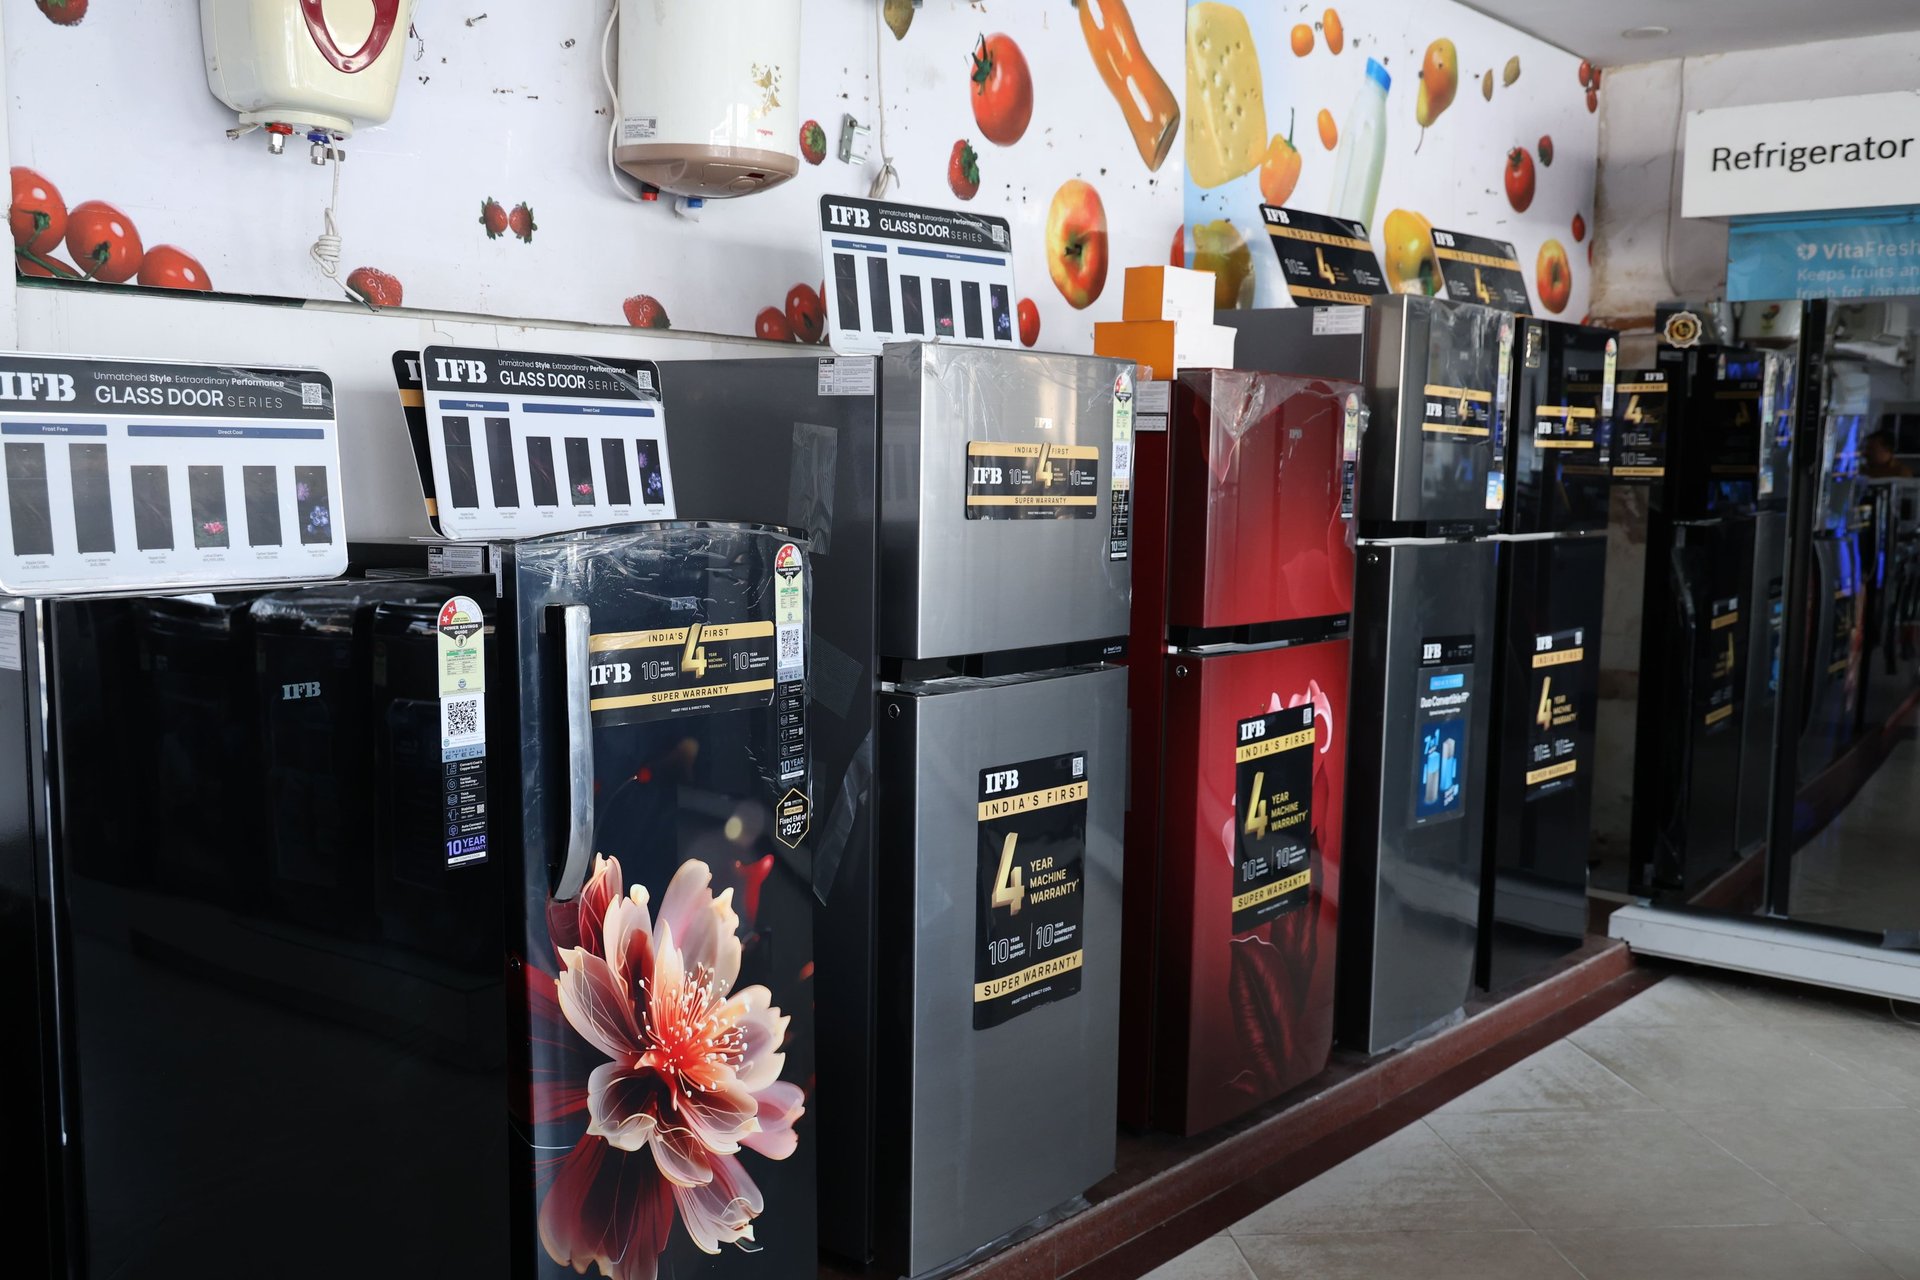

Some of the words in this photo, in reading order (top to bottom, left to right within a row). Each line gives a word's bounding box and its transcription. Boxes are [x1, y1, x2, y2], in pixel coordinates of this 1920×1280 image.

[1712, 137, 1914, 173] Refrigerator
[828, 204, 871, 229] IFB
[878, 208, 908, 218] Unmatched
[922, 213, 952, 224] Extraordinary
[1264, 207, 1290, 224] IFB
[880, 217, 917, 235] GLASS
[918, 222, 950, 239] DOOR
[951, 230, 983, 243] SERIES
[1823, 239, 1920, 260] VitaFresh
[1315, 247, 1336, 285] 4
[1797, 268, 1846, 283] Keeps
[1851, 265, 1895, 279] fruits
[1842, 285, 1865, 297] for
[434, 358, 488, 384] IFB
[497, 359, 535, 368] Unmatched
[552, 363, 590, 373] Extraordinary
[590, 365, 626, 374] Performance
[0, 371, 77, 402] IFB
[94, 371, 148, 382] Unmatched
[149, 374, 174, 384] Style.
[175, 376, 229, 388] Extraordinary
[231, 377, 285, 388] Performance
[500, 370, 546, 387] GLASS
[547, 373, 586, 390] DOOR
[588, 380, 626, 392] SERIES
[95, 385, 164, 405] GLASS
[168, 388, 224, 407] DOOR
[227, 396, 283, 409] SERIES
[1624, 394, 1643, 424] 4
[1014, 446, 1039, 454] INDIA'S
[1051, 447, 1069, 455] FIRST
[972, 467, 1003, 485] IFB
[1036, 442, 1054, 488] 4
[1009, 468, 1022, 485] 10
[1070, 469, 1081, 486] 10
[648, 632, 684, 643] INDIA'S
[704, 628, 729, 638] FIRST
[681, 622, 707, 679] 4
[733, 651, 750, 671] 10
[1423, 643, 1442, 659] IFB
[590, 662, 632, 686] IFB
[642, 660, 660, 681] 10
[282, 681, 322, 700] IFB
[651, 691, 680, 702] SUPER
[682, 686, 729, 698] WARRANTY
[1536, 676, 1553, 731] 4
[1241, 719, 1266, 741] IFB
[1241, 740, 1280, 759] INDIA'S
[1284, 732, 1311, 748] FIRST
[780, 760, 790, 774] 10
[790, 757, 804, 767] YEAR
[985, 769, 1019, 794] IFB
[985, 795, 1039, 817] INDIA'S
[1047, 785, 1083, 803] FIRST
[1244, 771, 1268, 840] 4
[1271, 791, 1289, 805] YEAR
[780, 815, 793, 825] Fixed
[793, 813, 802, 822] EMI
[1271, 801, 1299, 818] MACHINE
[446, 840, 462, 856] 10
[462, 835, 486, 848] YEAR
[1030, 856, 1053, 872] YEAR
[1276, 847, 1290, 870] 10
[991, 832, 1025, 916] 4
[1030, 869, 1067, 888] MACHINE
[1241, 859, 1256, 882] 10
[1238, 890, 1264, 908] SUPER
[1267, 875, 1307, 896] WARRANTY
[1036, 923, 1054, 950] 10
[988, 938, 1010, 966] 10
[1010, 935, 1020, 943] YEAR
[984, 976, 1020, 997] SUPER
[1023, 955, 1078, 982] WARRANTY
